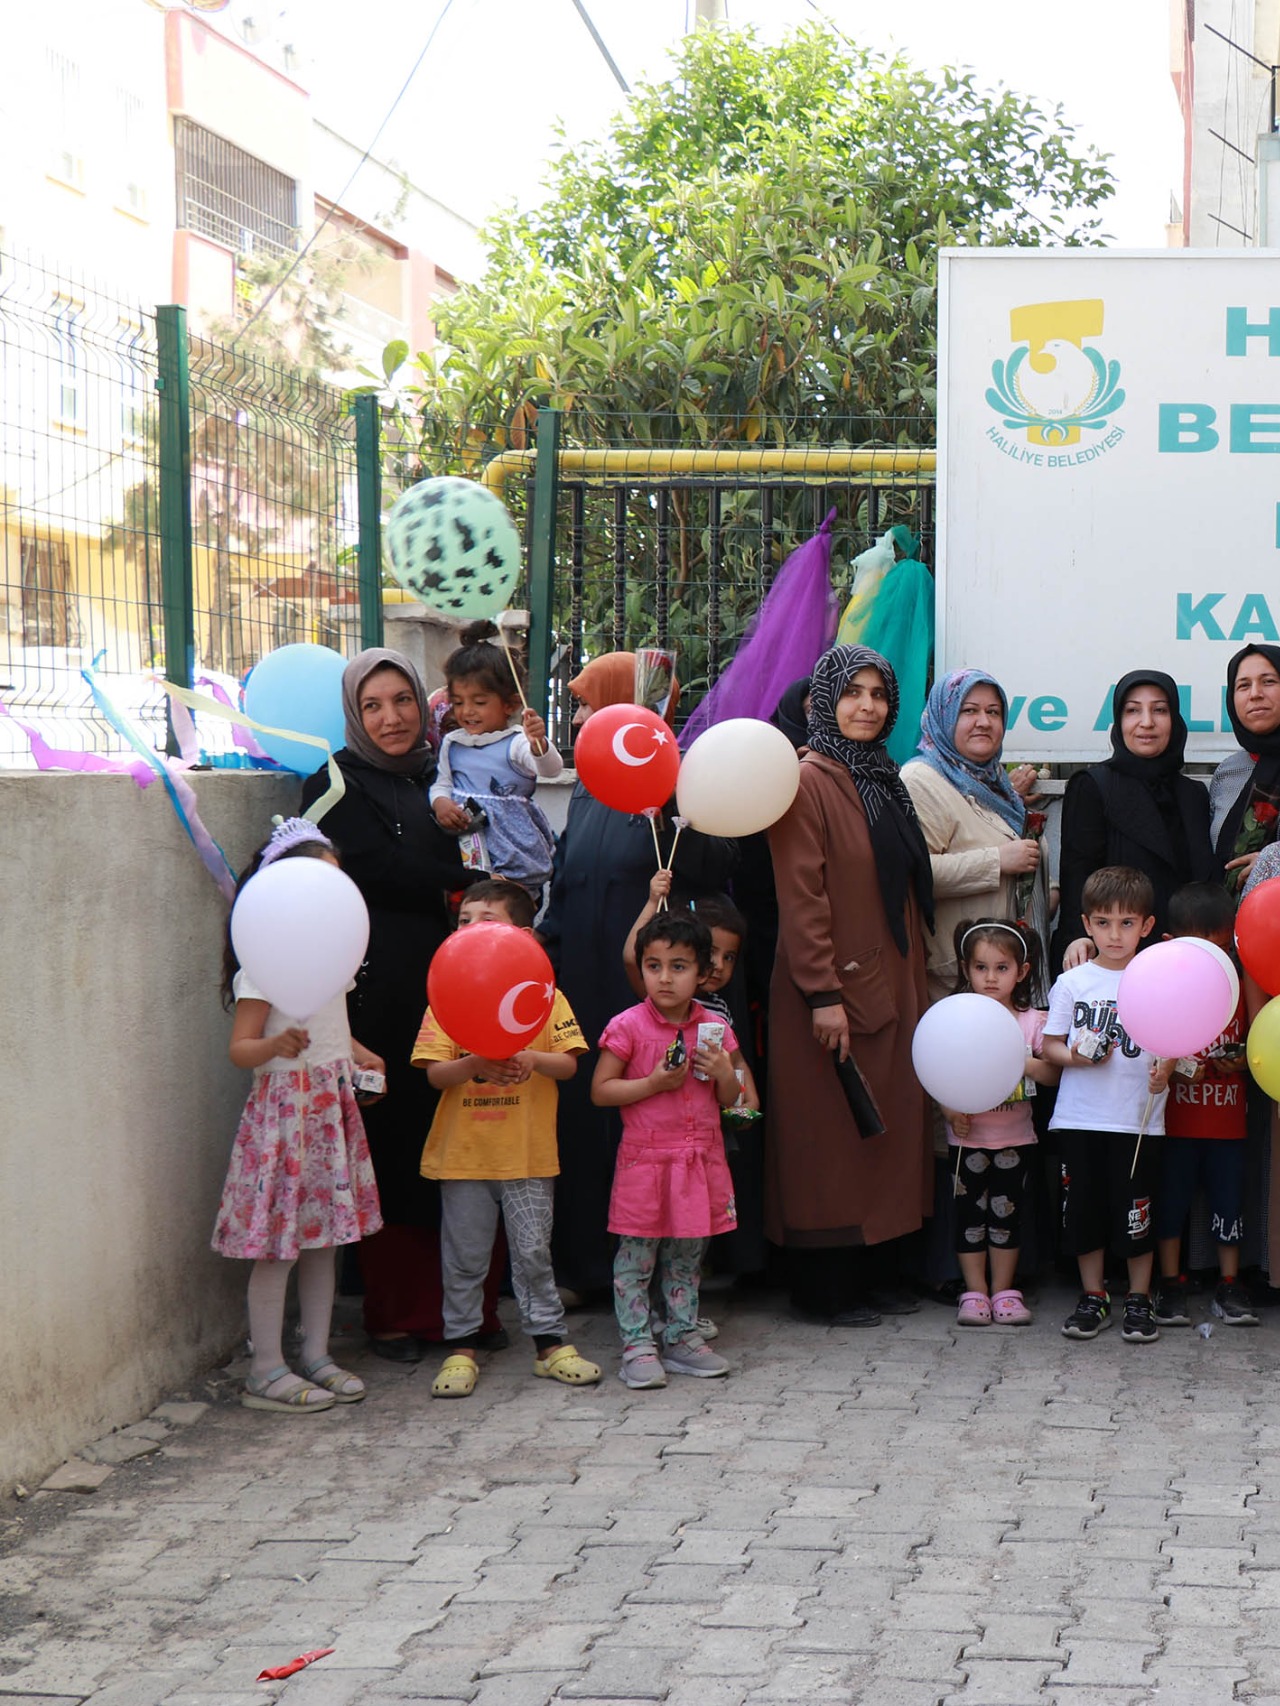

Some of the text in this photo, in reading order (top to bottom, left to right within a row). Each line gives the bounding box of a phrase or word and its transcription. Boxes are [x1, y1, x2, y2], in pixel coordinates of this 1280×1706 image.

[986, 425, 1126, 468] HALİLİYE BELEDİYESİ
[463, 1096, 520, 1107] BE COMFORTABLE
[1176, 1083, 1239, 1106] REPEAT
